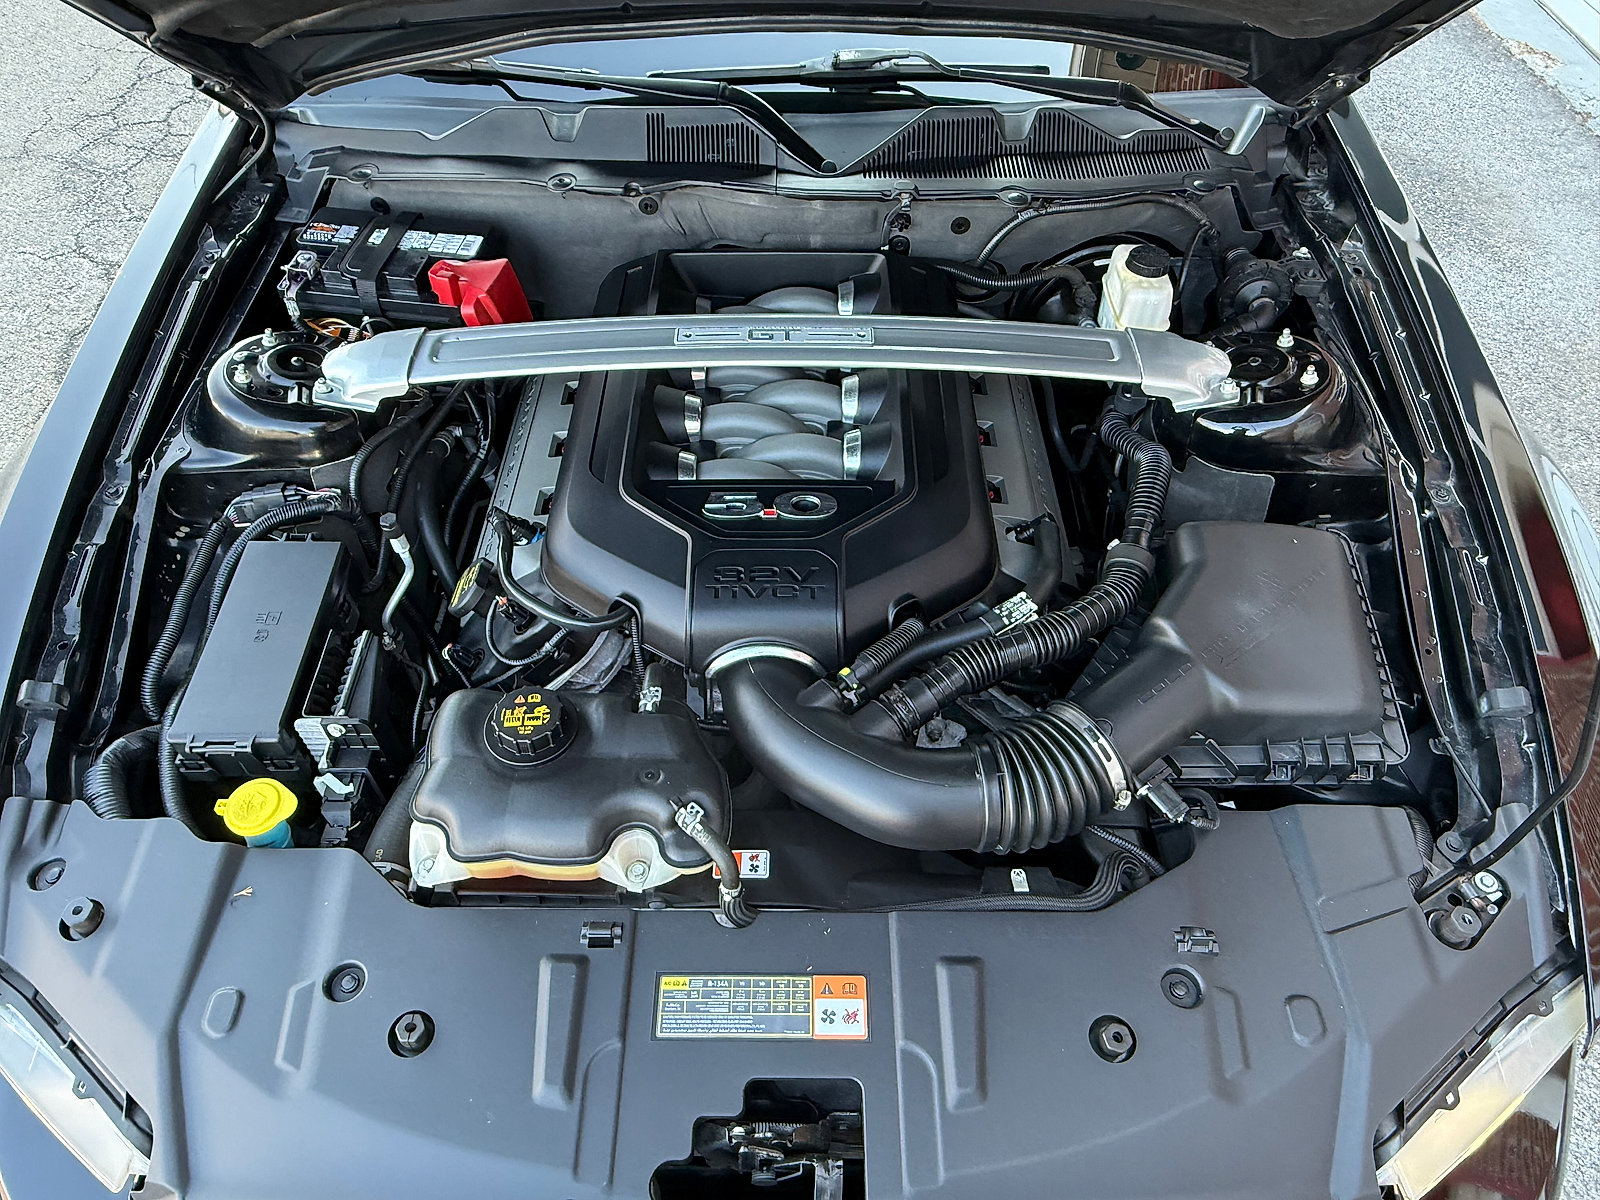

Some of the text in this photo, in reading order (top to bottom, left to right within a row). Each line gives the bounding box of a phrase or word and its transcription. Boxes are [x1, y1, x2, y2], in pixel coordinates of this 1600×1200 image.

[748, 328, 803, 341] GT
[702, 491, 838, 519] 5.0
[714, 566, 820, 582] 32V
